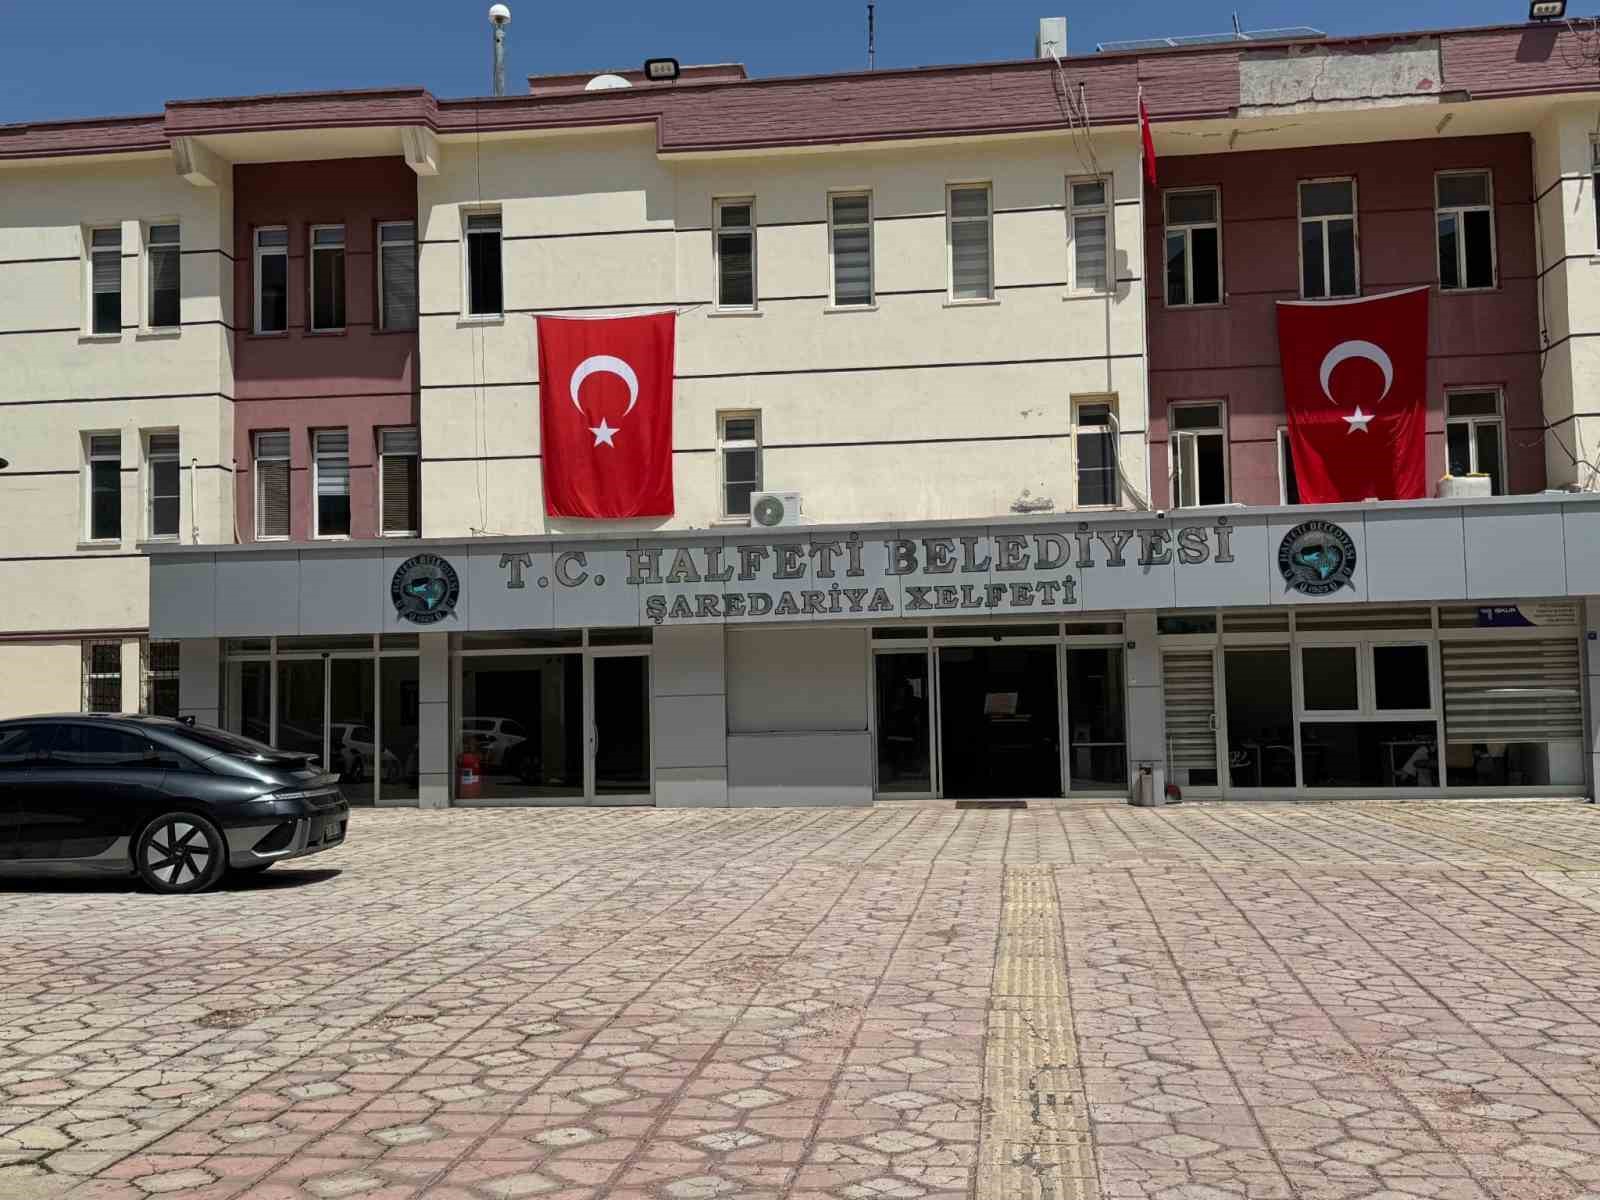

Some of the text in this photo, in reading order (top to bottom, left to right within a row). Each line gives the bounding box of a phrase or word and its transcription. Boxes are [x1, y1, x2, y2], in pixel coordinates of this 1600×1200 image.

[498, 551, 605, 589] T.C.
[625, 531, 865, 585] HALFETİ
[884, 516, 1235, 576] BELEDİYESİ
[646, 574, 1078, 624] ŞAREDARİYA XELFETİ
